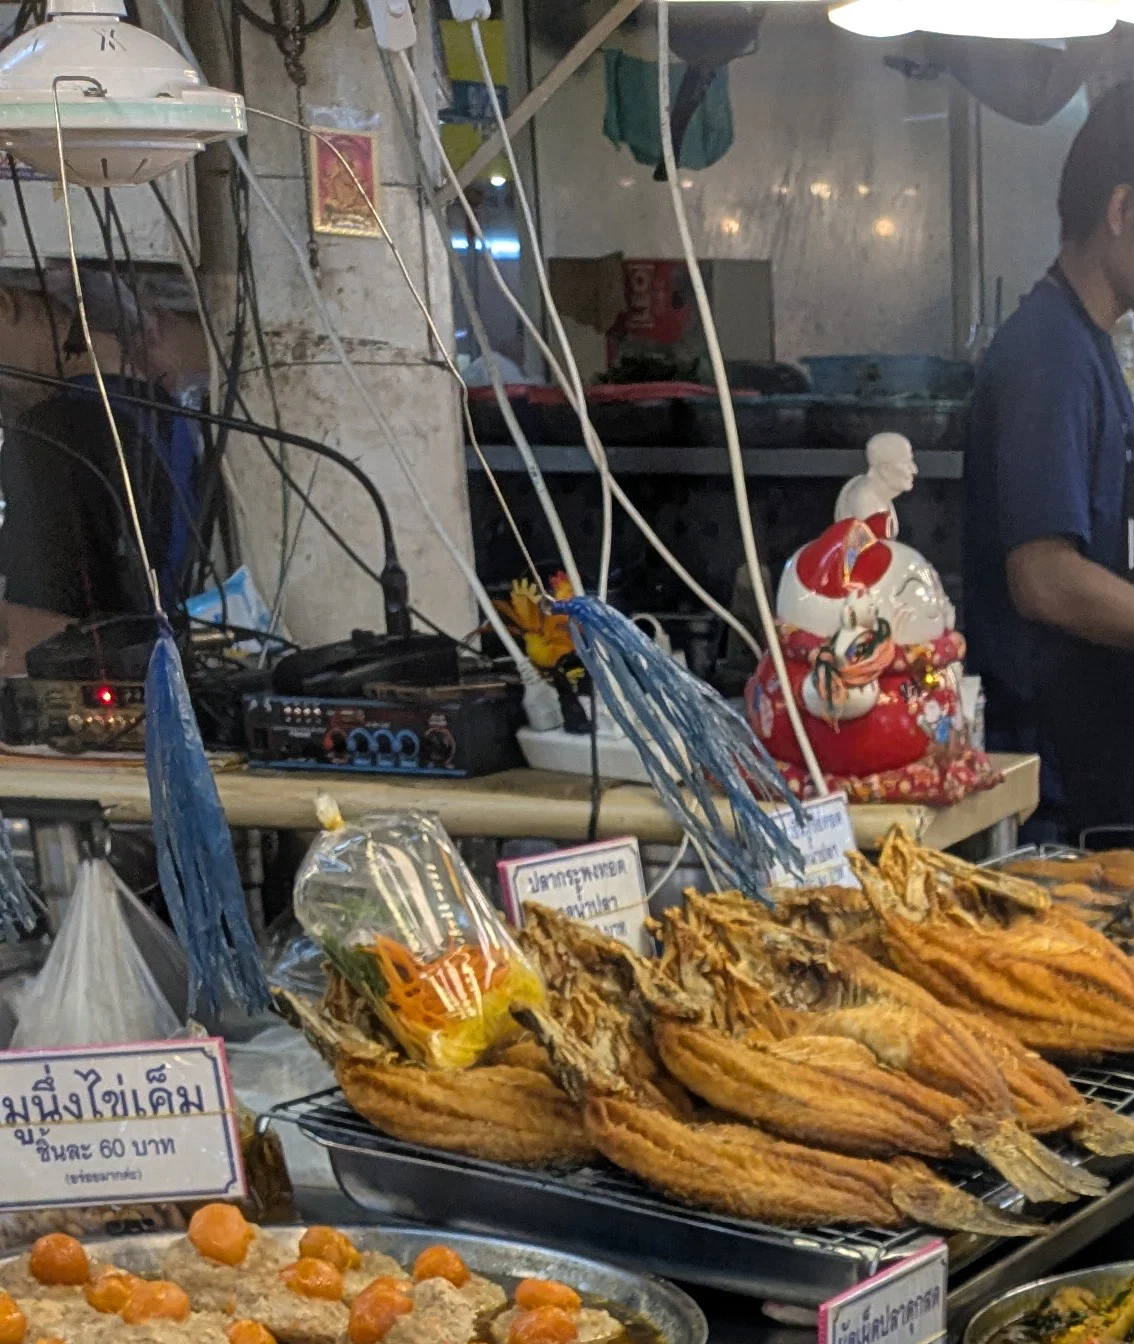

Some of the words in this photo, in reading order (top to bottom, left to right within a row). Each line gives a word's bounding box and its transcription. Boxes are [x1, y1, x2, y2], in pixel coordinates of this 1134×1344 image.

[2, 1063, 206, 1145] มูนึ่งไข่เค็ม
[35, 1127, 92, 1163] ชิ้นละ
[100, 1138, 125, 1158] 60
[131, 1136, 176, 1157] บาท
